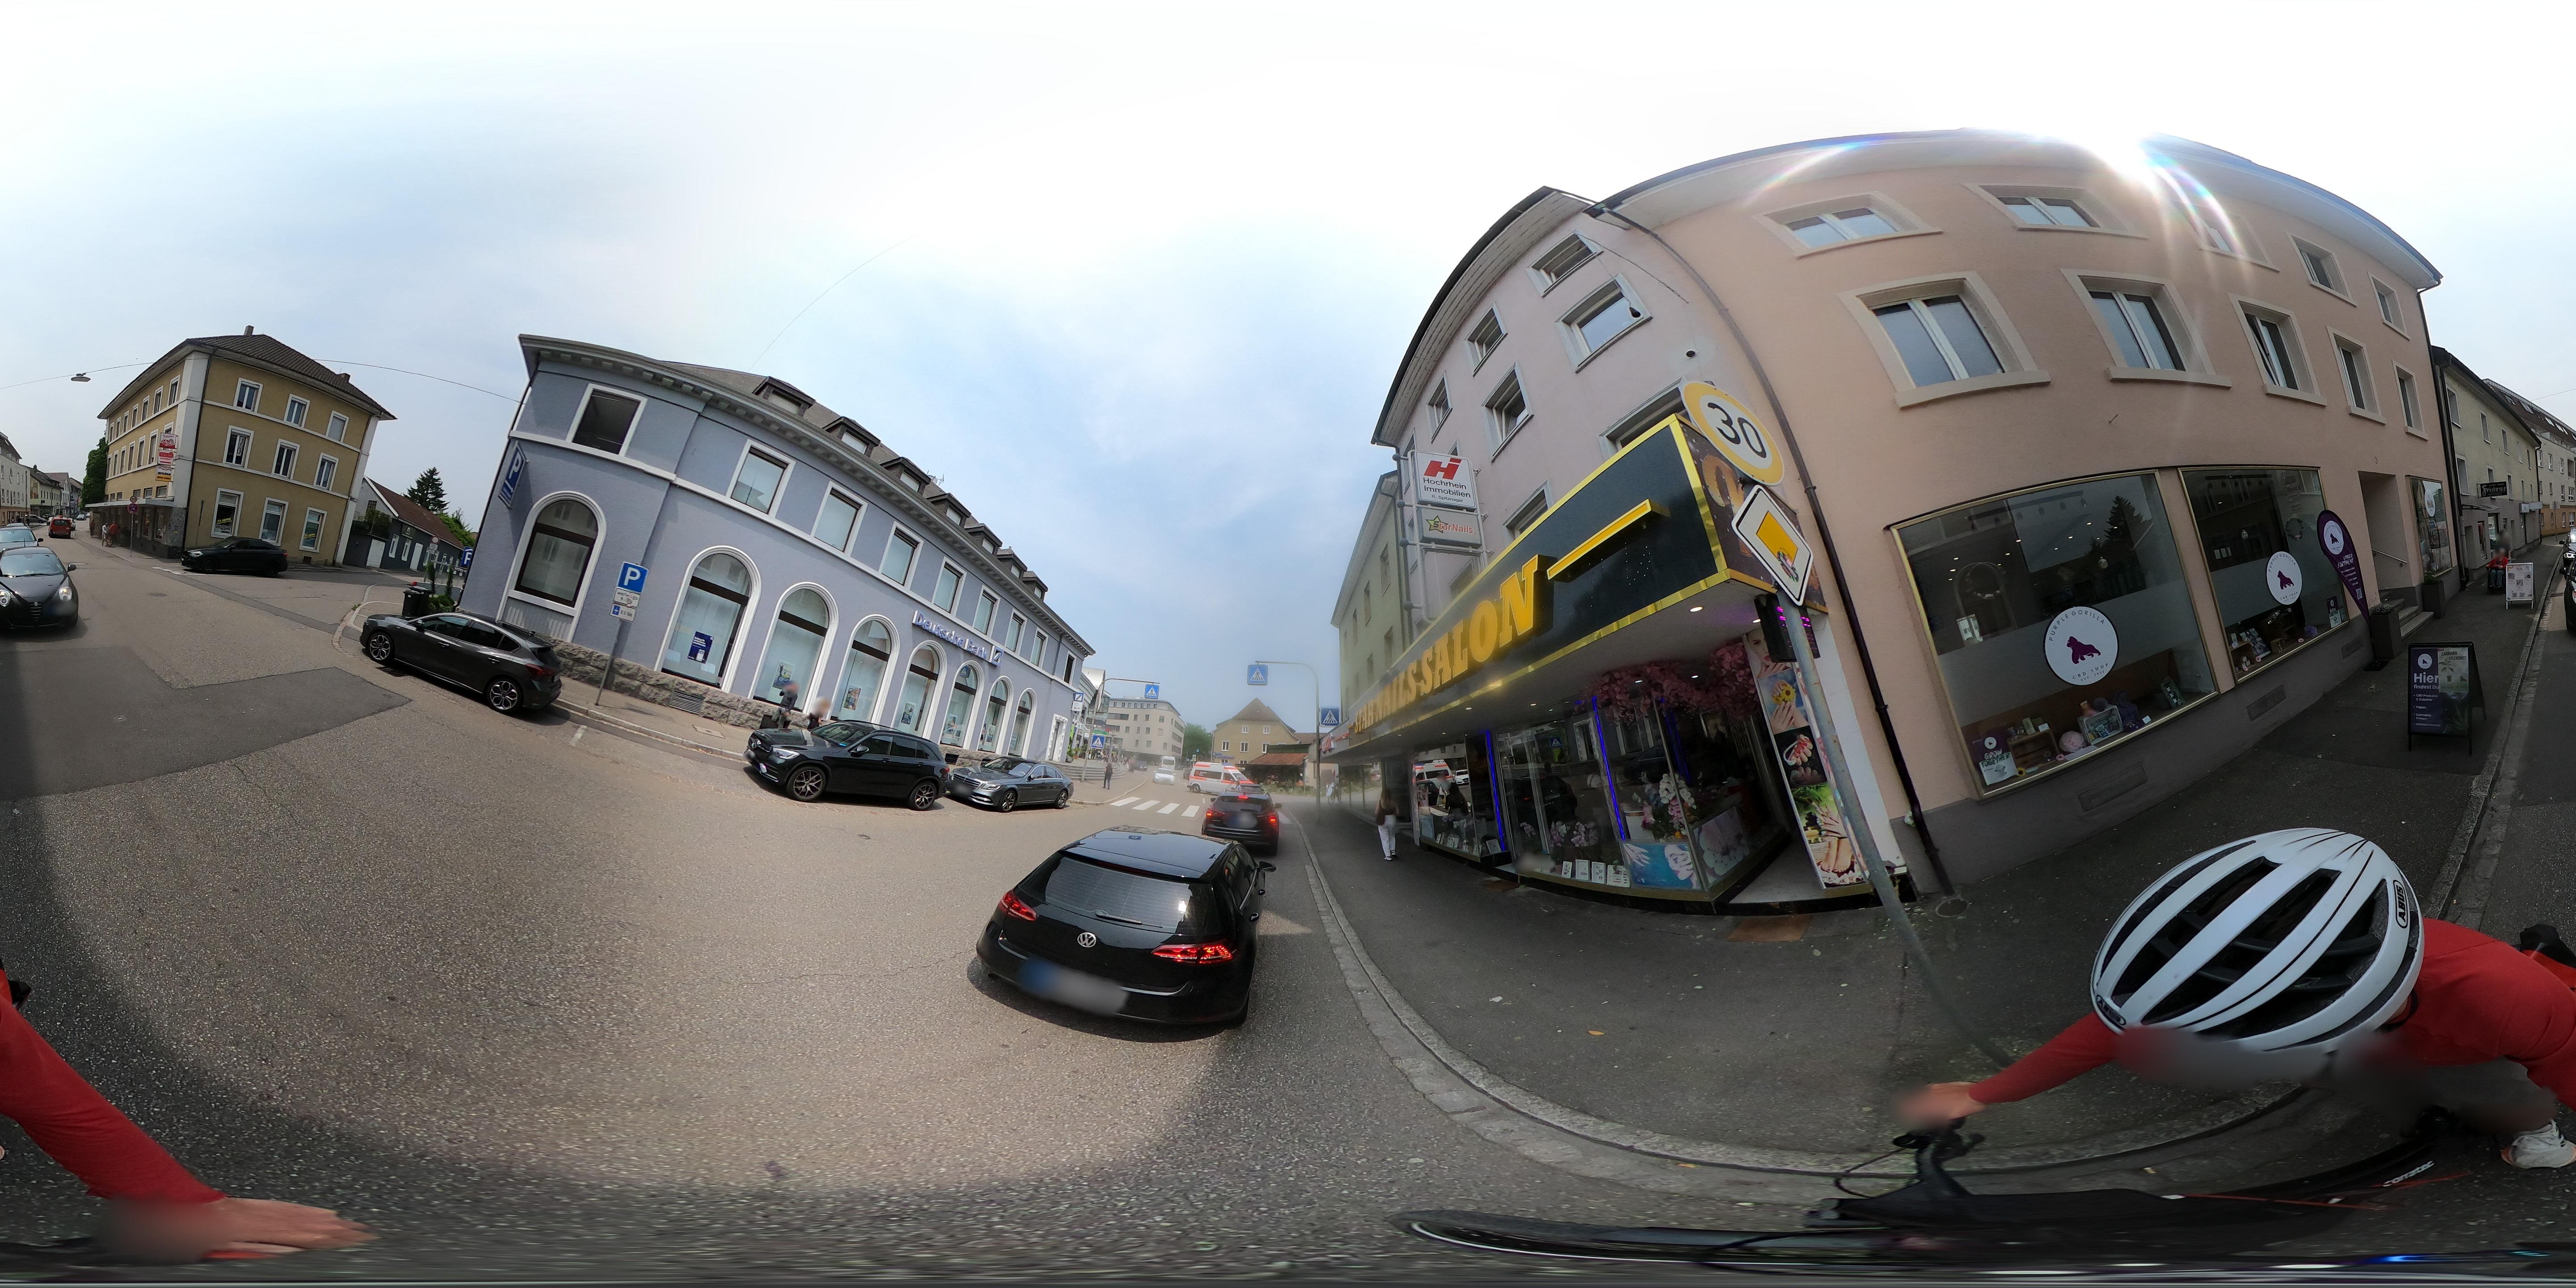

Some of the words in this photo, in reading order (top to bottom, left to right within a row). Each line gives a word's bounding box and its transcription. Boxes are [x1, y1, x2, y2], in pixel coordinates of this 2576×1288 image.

[1707, 402, 1767, 459] 30
[1423, 477, 1466, 490] Hochrhein
[1424, 485, 1471, 498] Immobilien
[623, 567, 641, 585] P
[1420, 554, 1538, 696] SALON
[2049, 614, 2070, 641] PURPLE
[2072, 610, 2105, 624] GORILLA
[912, 610, 963, 648] Deutsche
[964, 638, 988, 660] Bank
[2072, 672, 2087, 680] CBD
[2091, 663, 2109, 673] SHOP
[2414, 672, 2439, 683] Hier
[1984, 748, 2003, 760] GROW
[2396, 885, 2406, 923] ABUS
